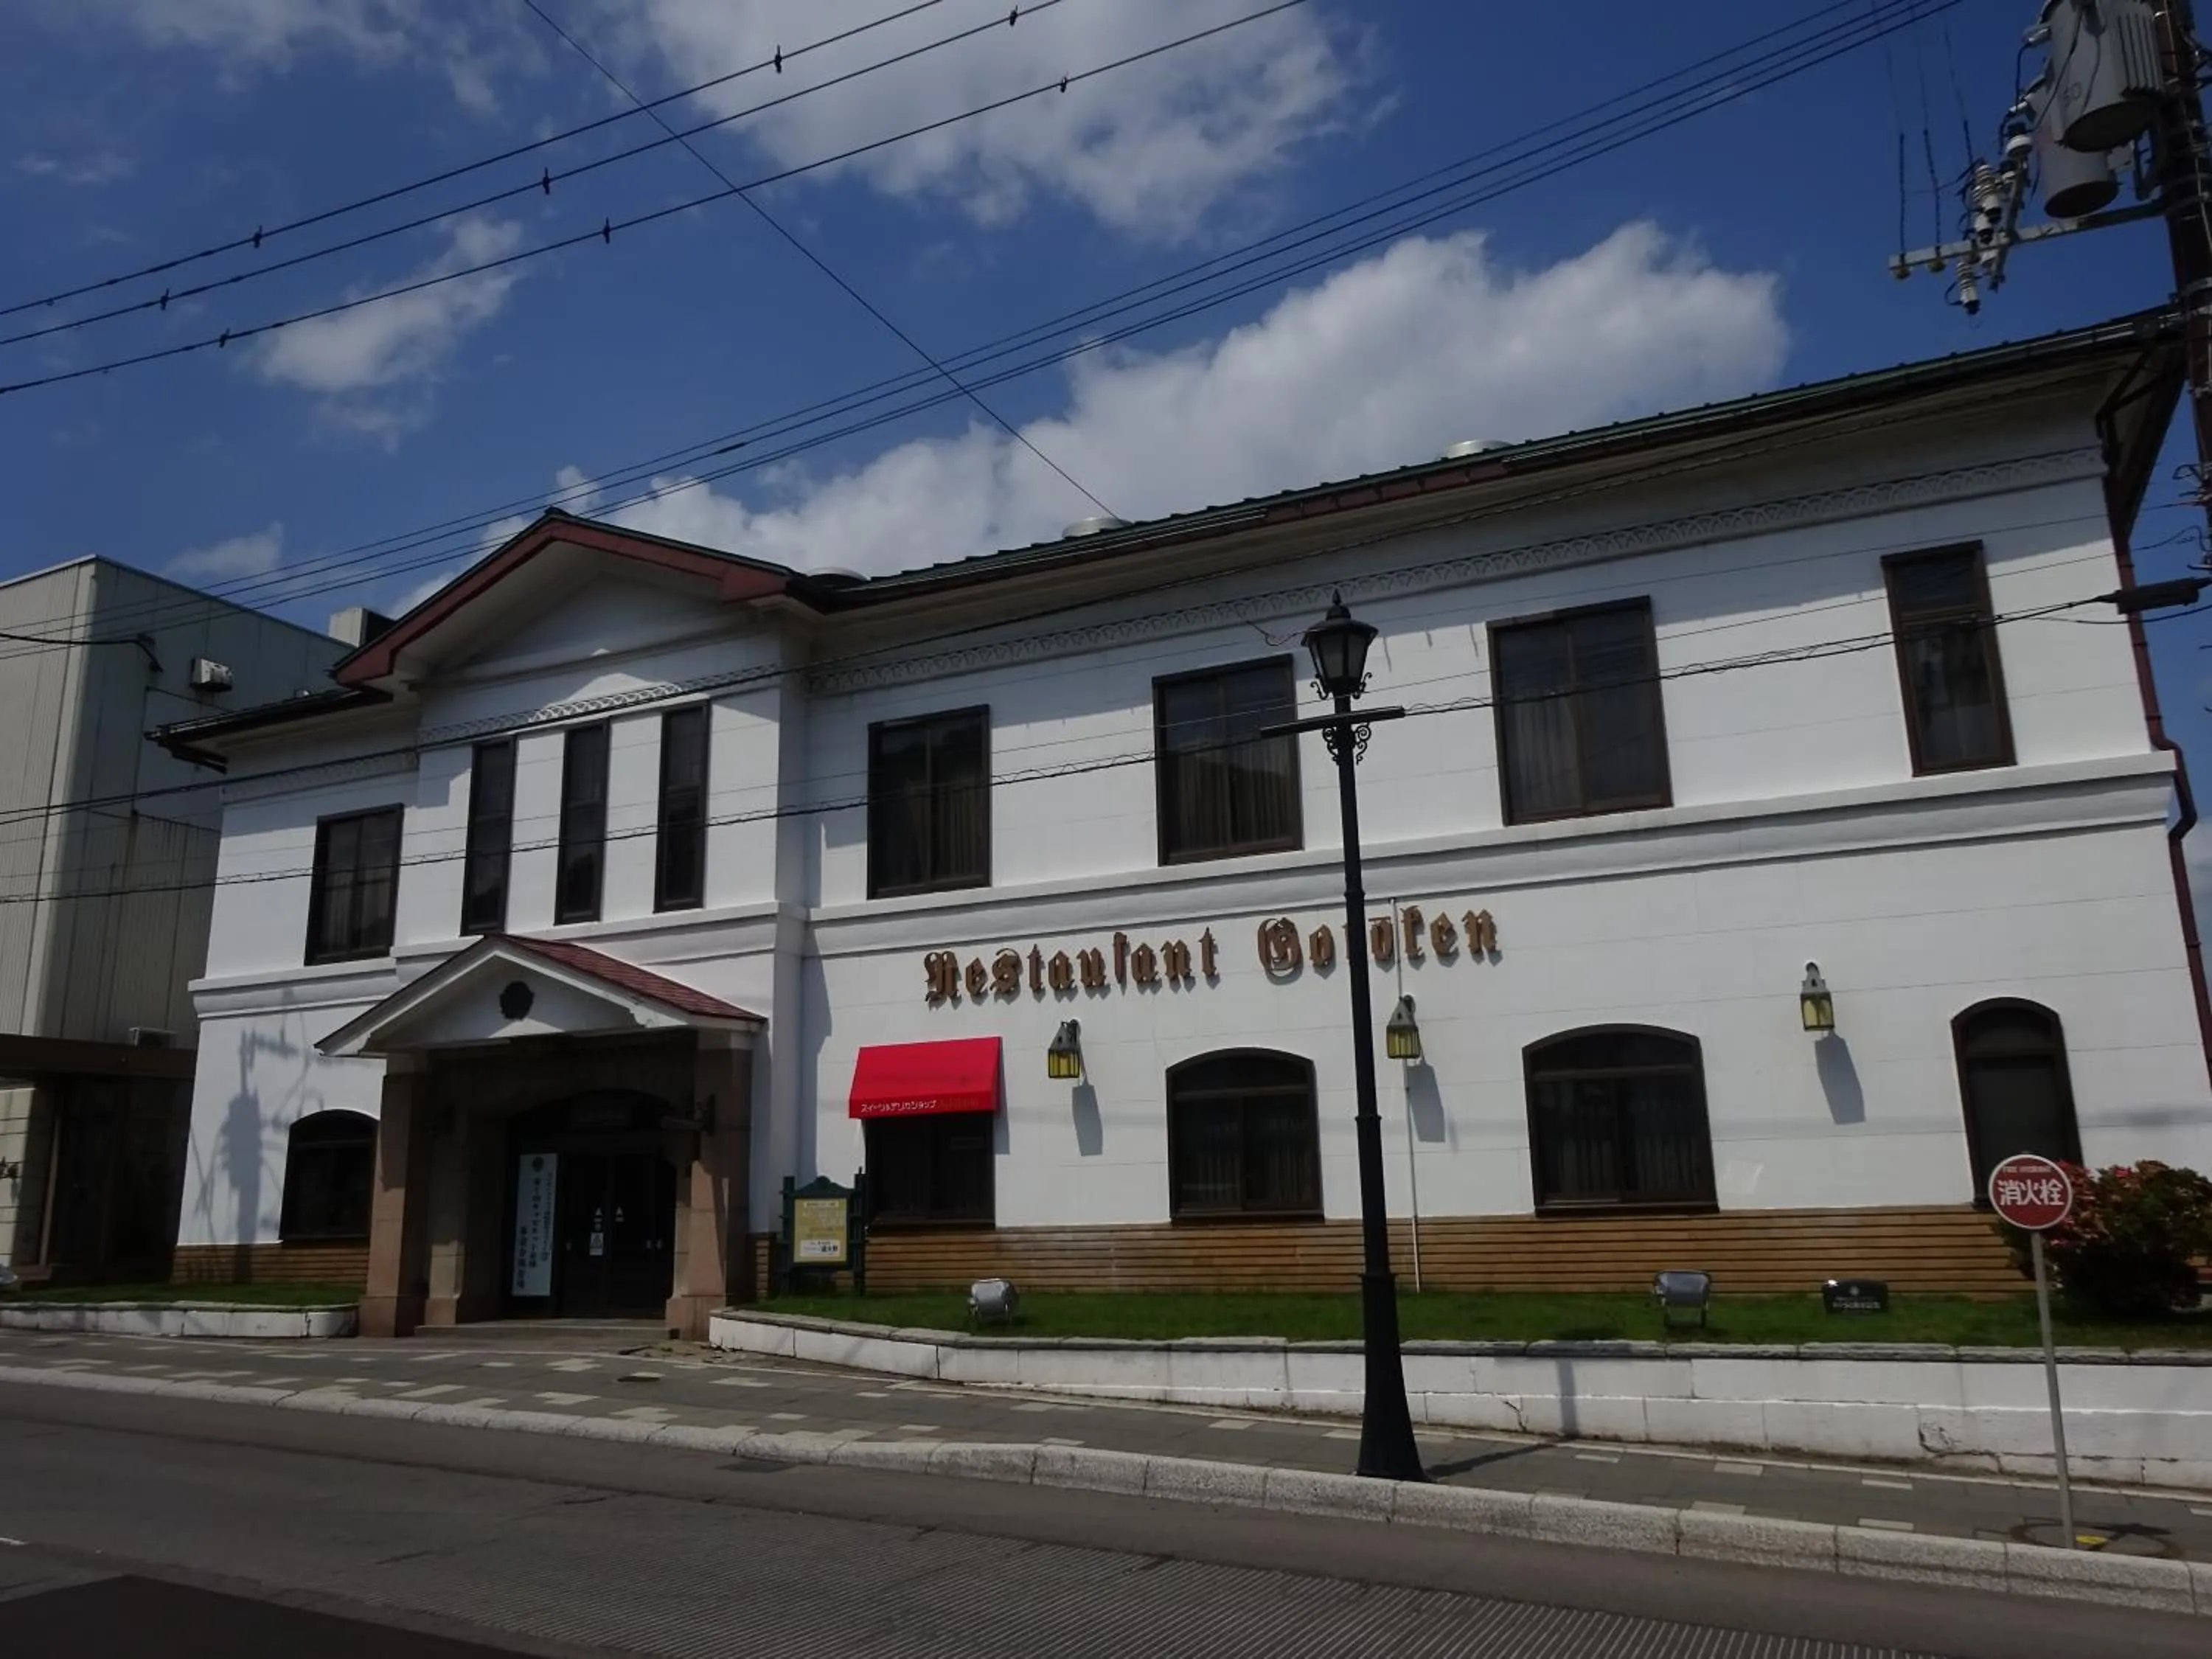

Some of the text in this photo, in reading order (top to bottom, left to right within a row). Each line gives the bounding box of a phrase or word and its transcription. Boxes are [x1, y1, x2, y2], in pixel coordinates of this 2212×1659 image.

[924, 926, 1217, 1002] Restaurant
[1997, 1178, 2065, 1205] 消火栓
